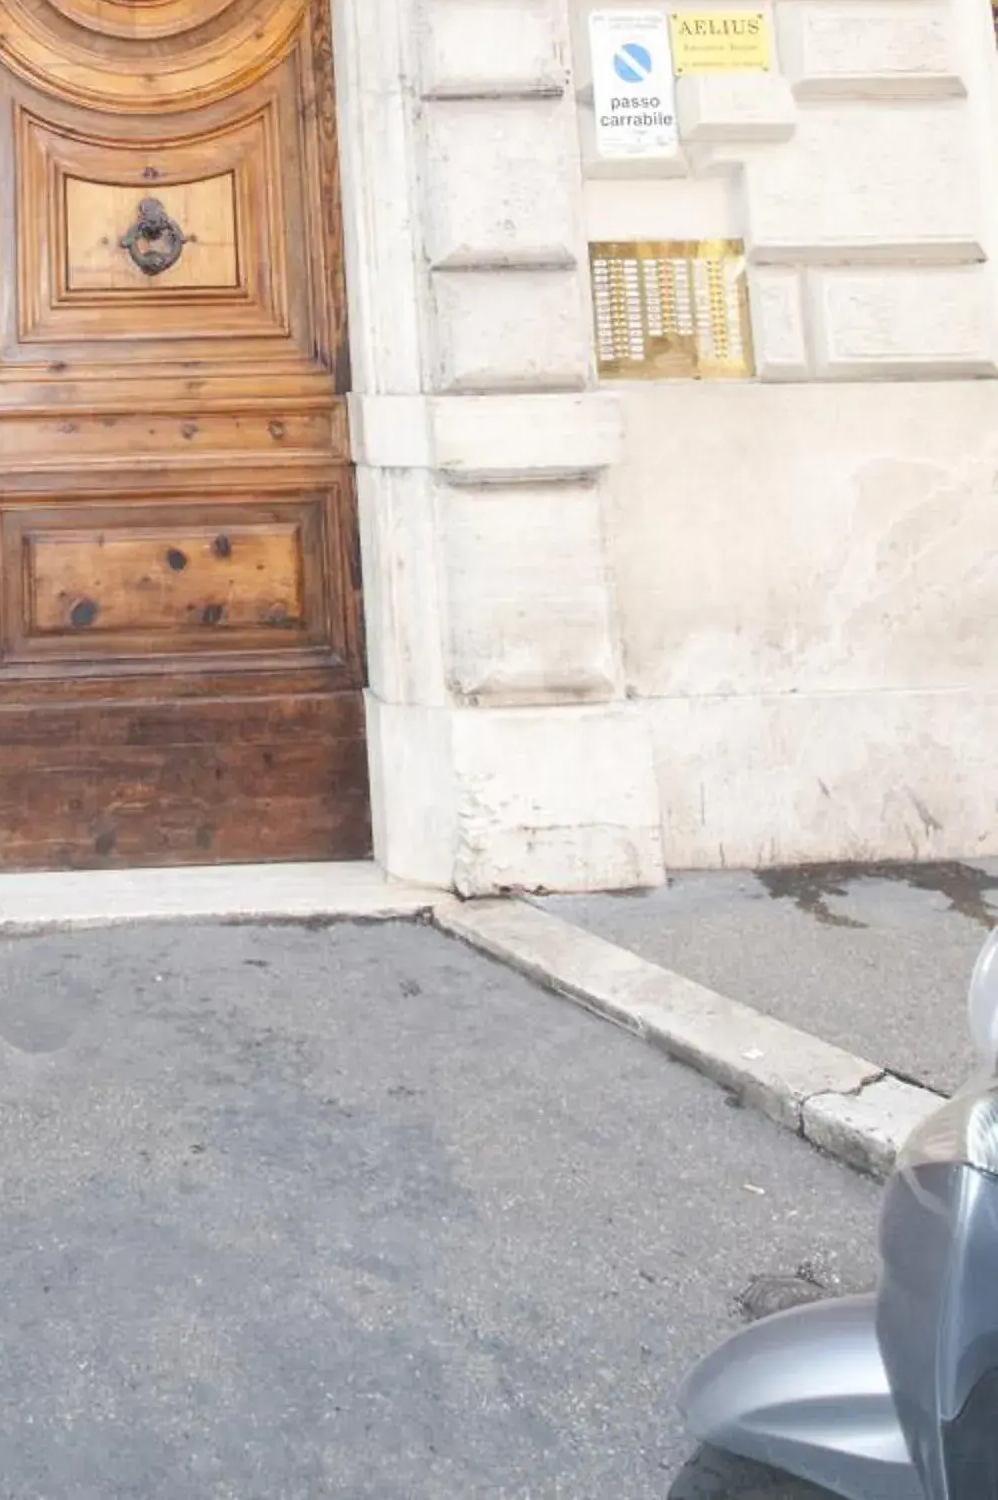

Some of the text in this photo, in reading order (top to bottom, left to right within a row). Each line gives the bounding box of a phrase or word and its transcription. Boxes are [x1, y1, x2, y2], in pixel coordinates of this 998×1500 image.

[680, 18, 760, 36] AELIUS
[610, 97, 661, 110] passo
[600, 112, 674, 127] carrabile
